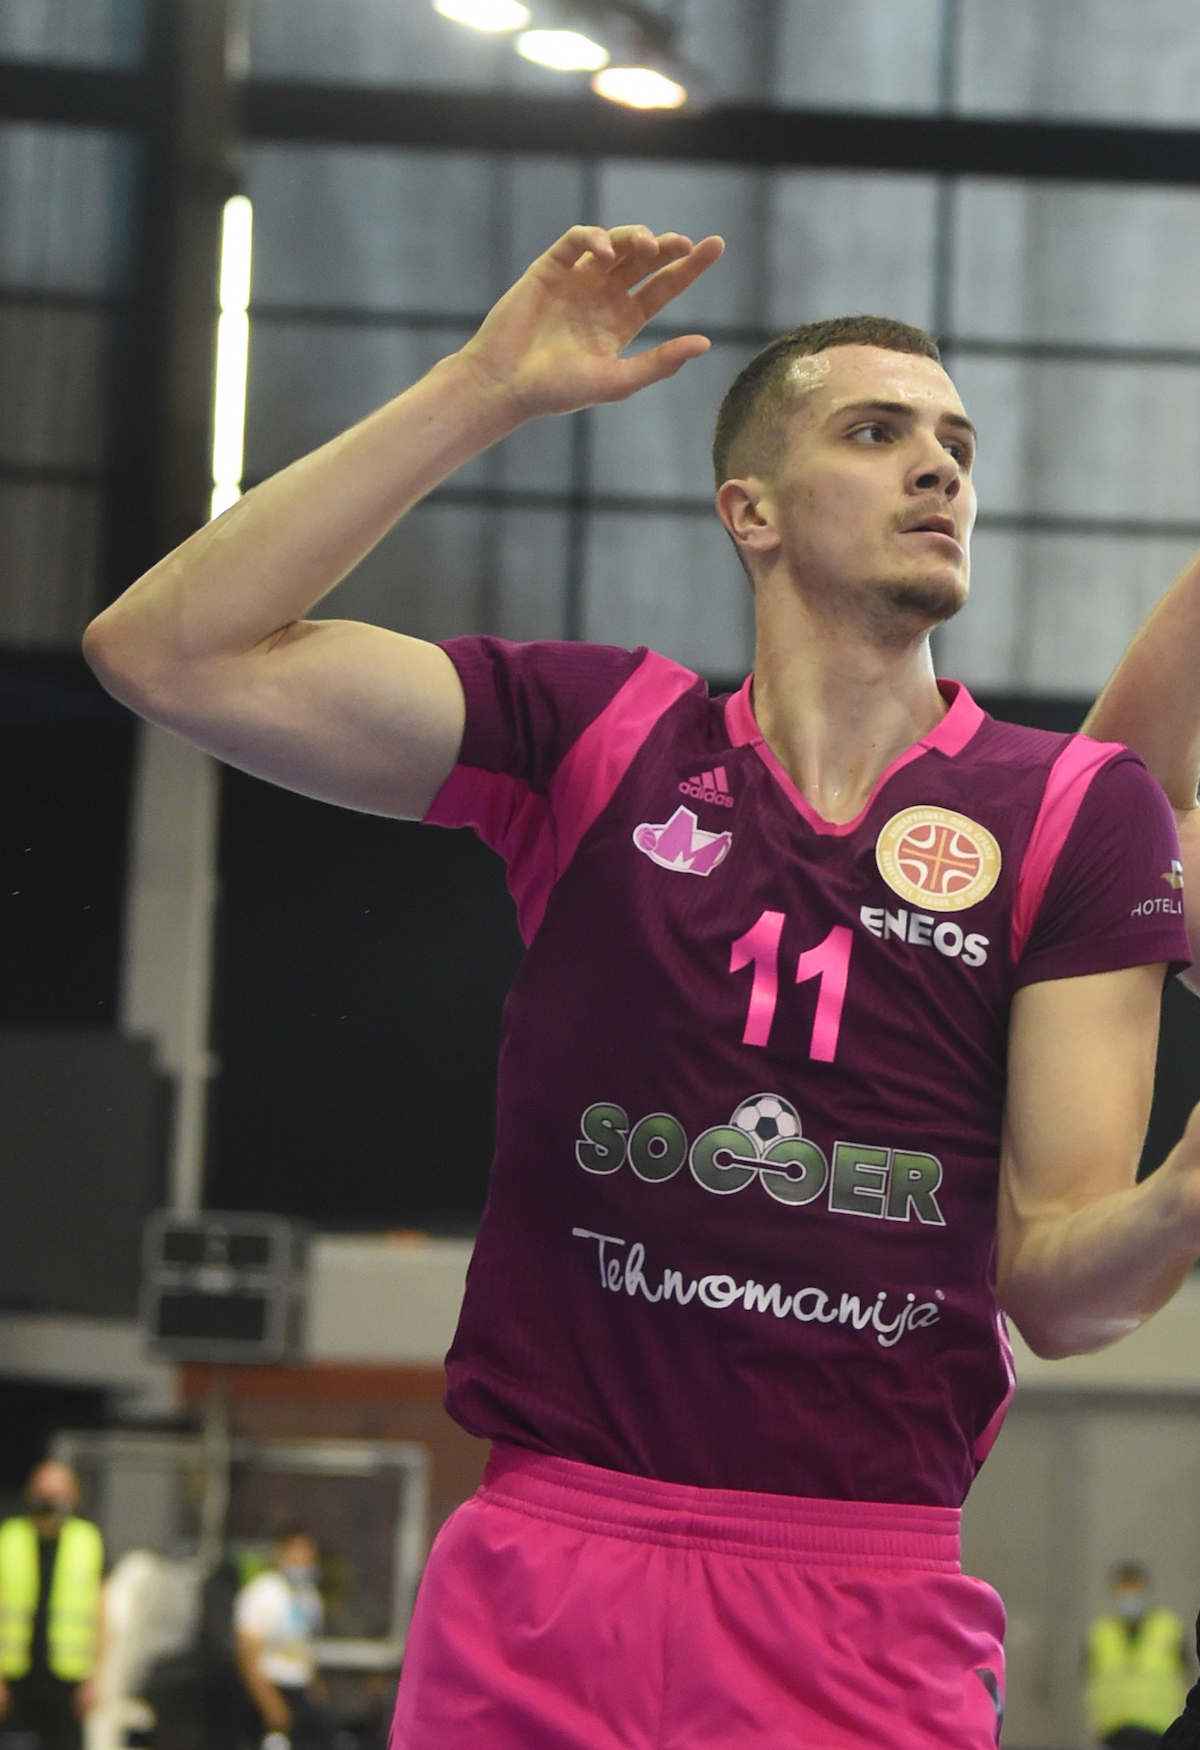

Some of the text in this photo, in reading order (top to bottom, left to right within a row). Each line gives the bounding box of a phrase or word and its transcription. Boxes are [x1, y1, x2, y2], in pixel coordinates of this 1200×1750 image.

[678, 781, 735, 808] adidas
[860, 905, 990, 967] ENEOS
[1130, 897, 1182, 917] HOTELI
[729, 909, 854, 1063] 11
[575, 1098, 947, 1226] SOCCER
[572, 1227, 941, 1346] Tehnomanija
